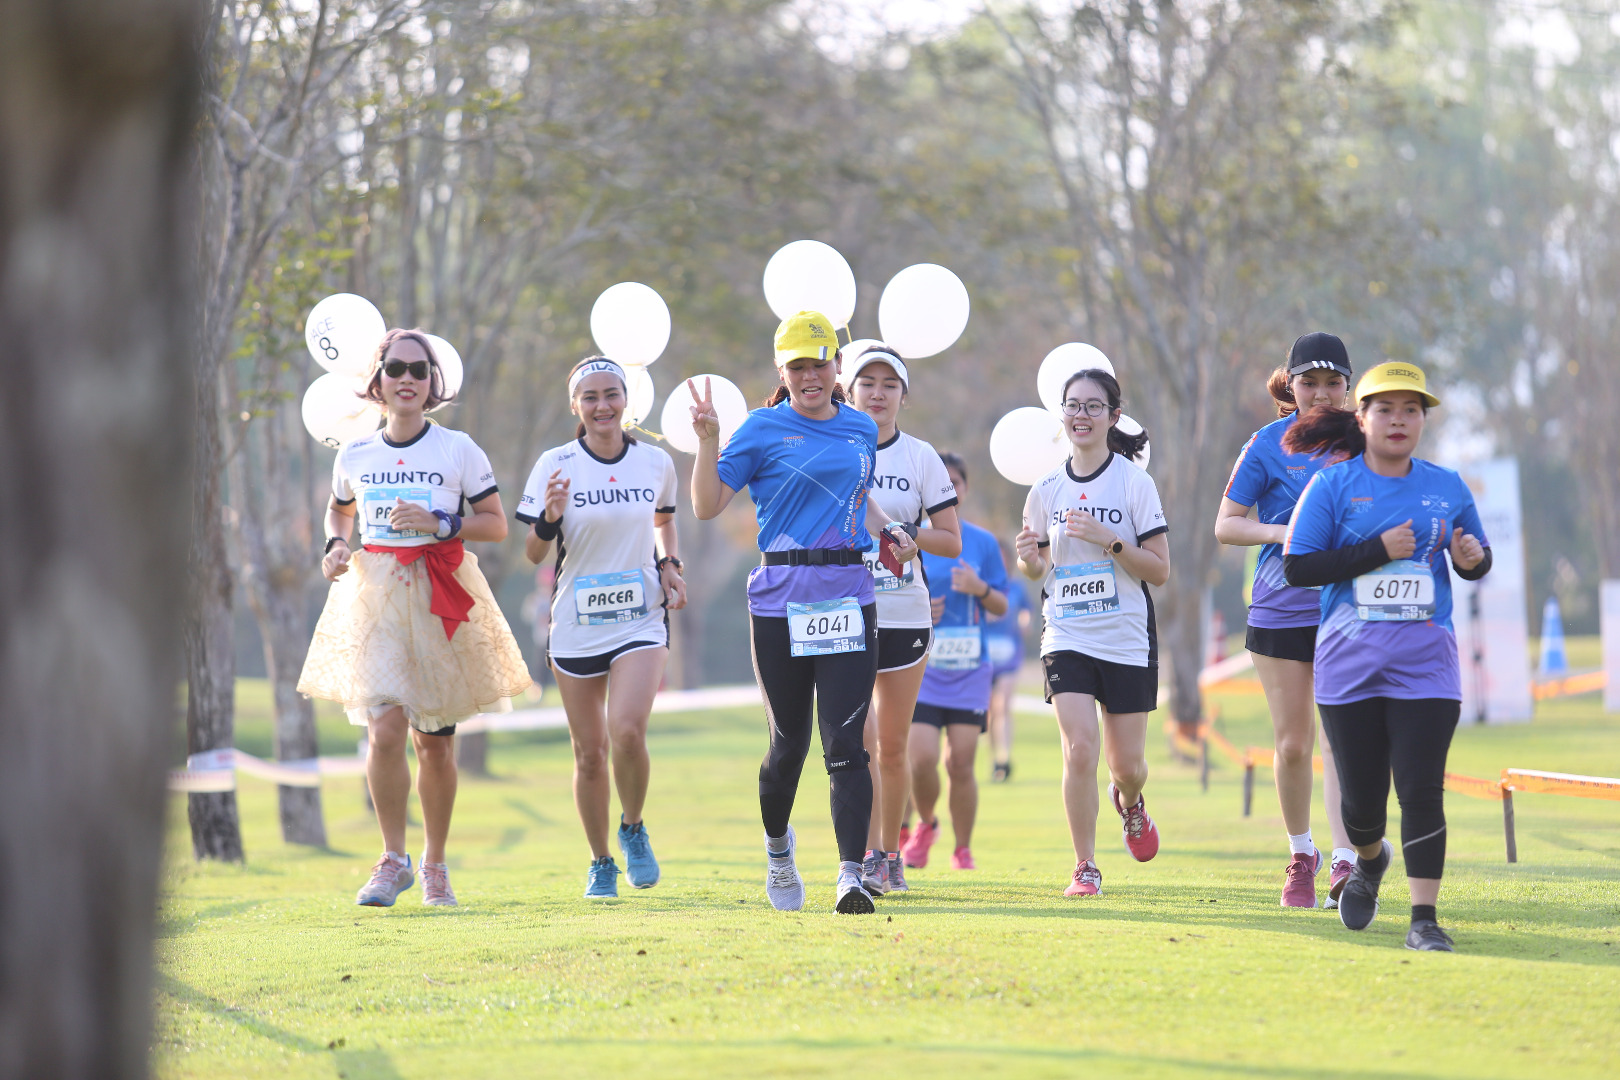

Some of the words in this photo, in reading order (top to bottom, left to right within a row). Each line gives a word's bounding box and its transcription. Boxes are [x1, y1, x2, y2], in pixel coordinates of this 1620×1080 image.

[309, 316, 336, 345] ACE
[319, 336, 339, 361] 8
[581, 362, 615, 376] FILA
[1386, 368, 1420, 381] SEIKO
[360, 471, 444, 486] SUUNTO
[573, 488, 655, 508] SUUNTO
[588, 589, 634, 607] PACER
[1062, 580, 1105, 598] PACER
[1374, 579, 1420, 599] 6071
[632, 611, 641, 620] 16
[1103, 602, 1113, 611] 16
[806, 614, 849, 636] 6041
[849, 641, 859, 650] 16
